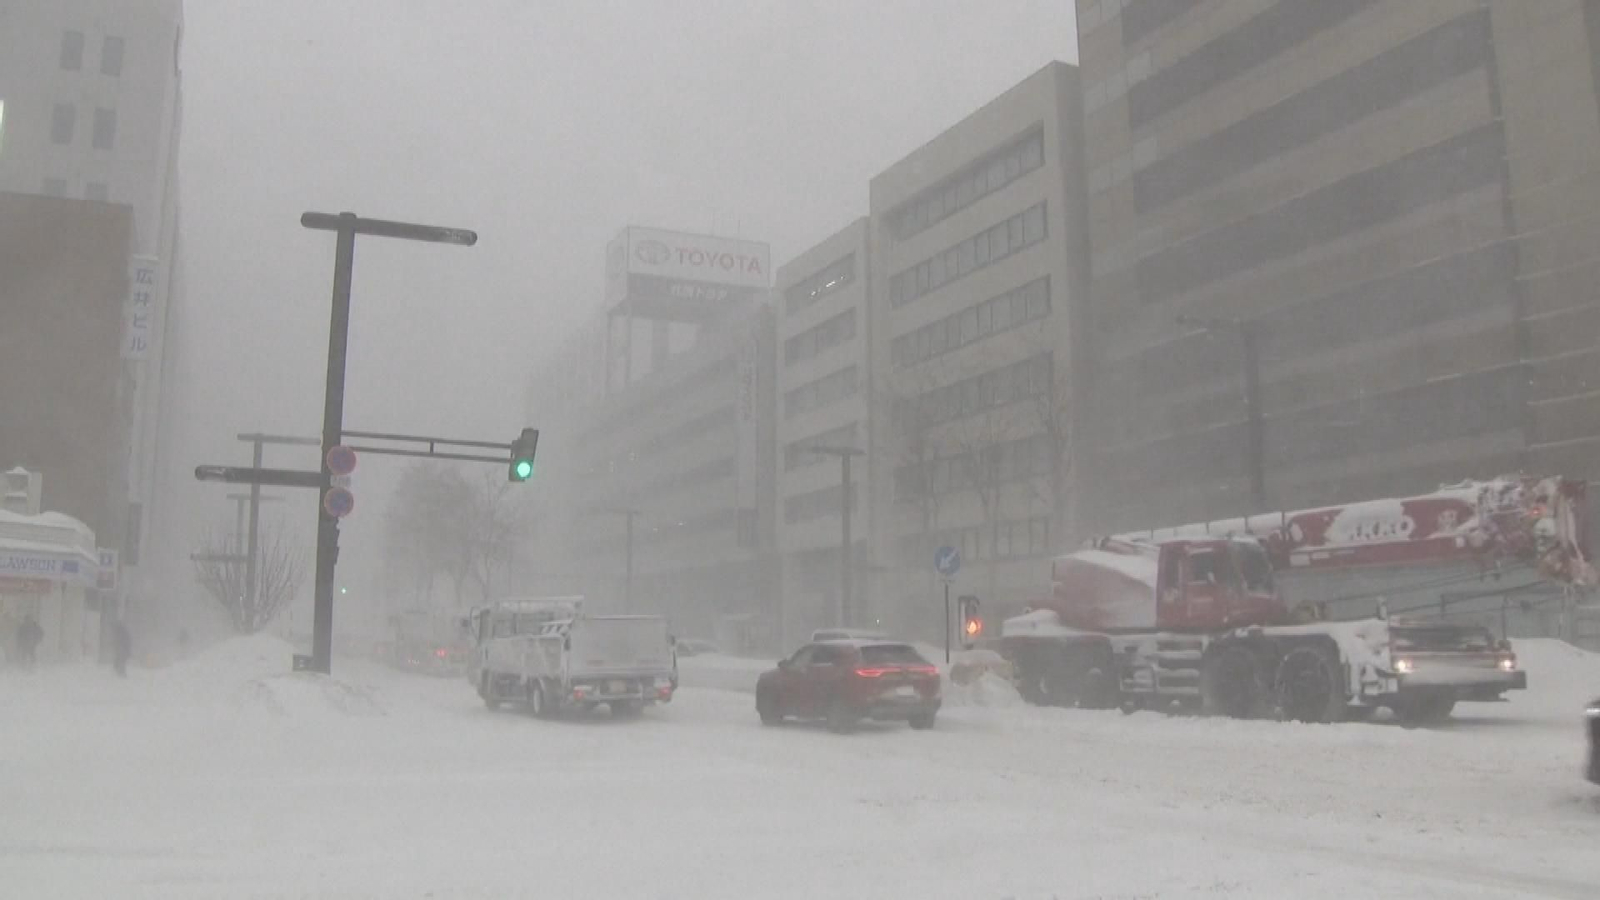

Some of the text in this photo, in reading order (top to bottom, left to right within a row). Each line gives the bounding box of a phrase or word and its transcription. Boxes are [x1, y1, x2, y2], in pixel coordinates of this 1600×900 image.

[676, 247, 761, 274] TOYOTA
[131, 268, 153, 351] 広井ビル
